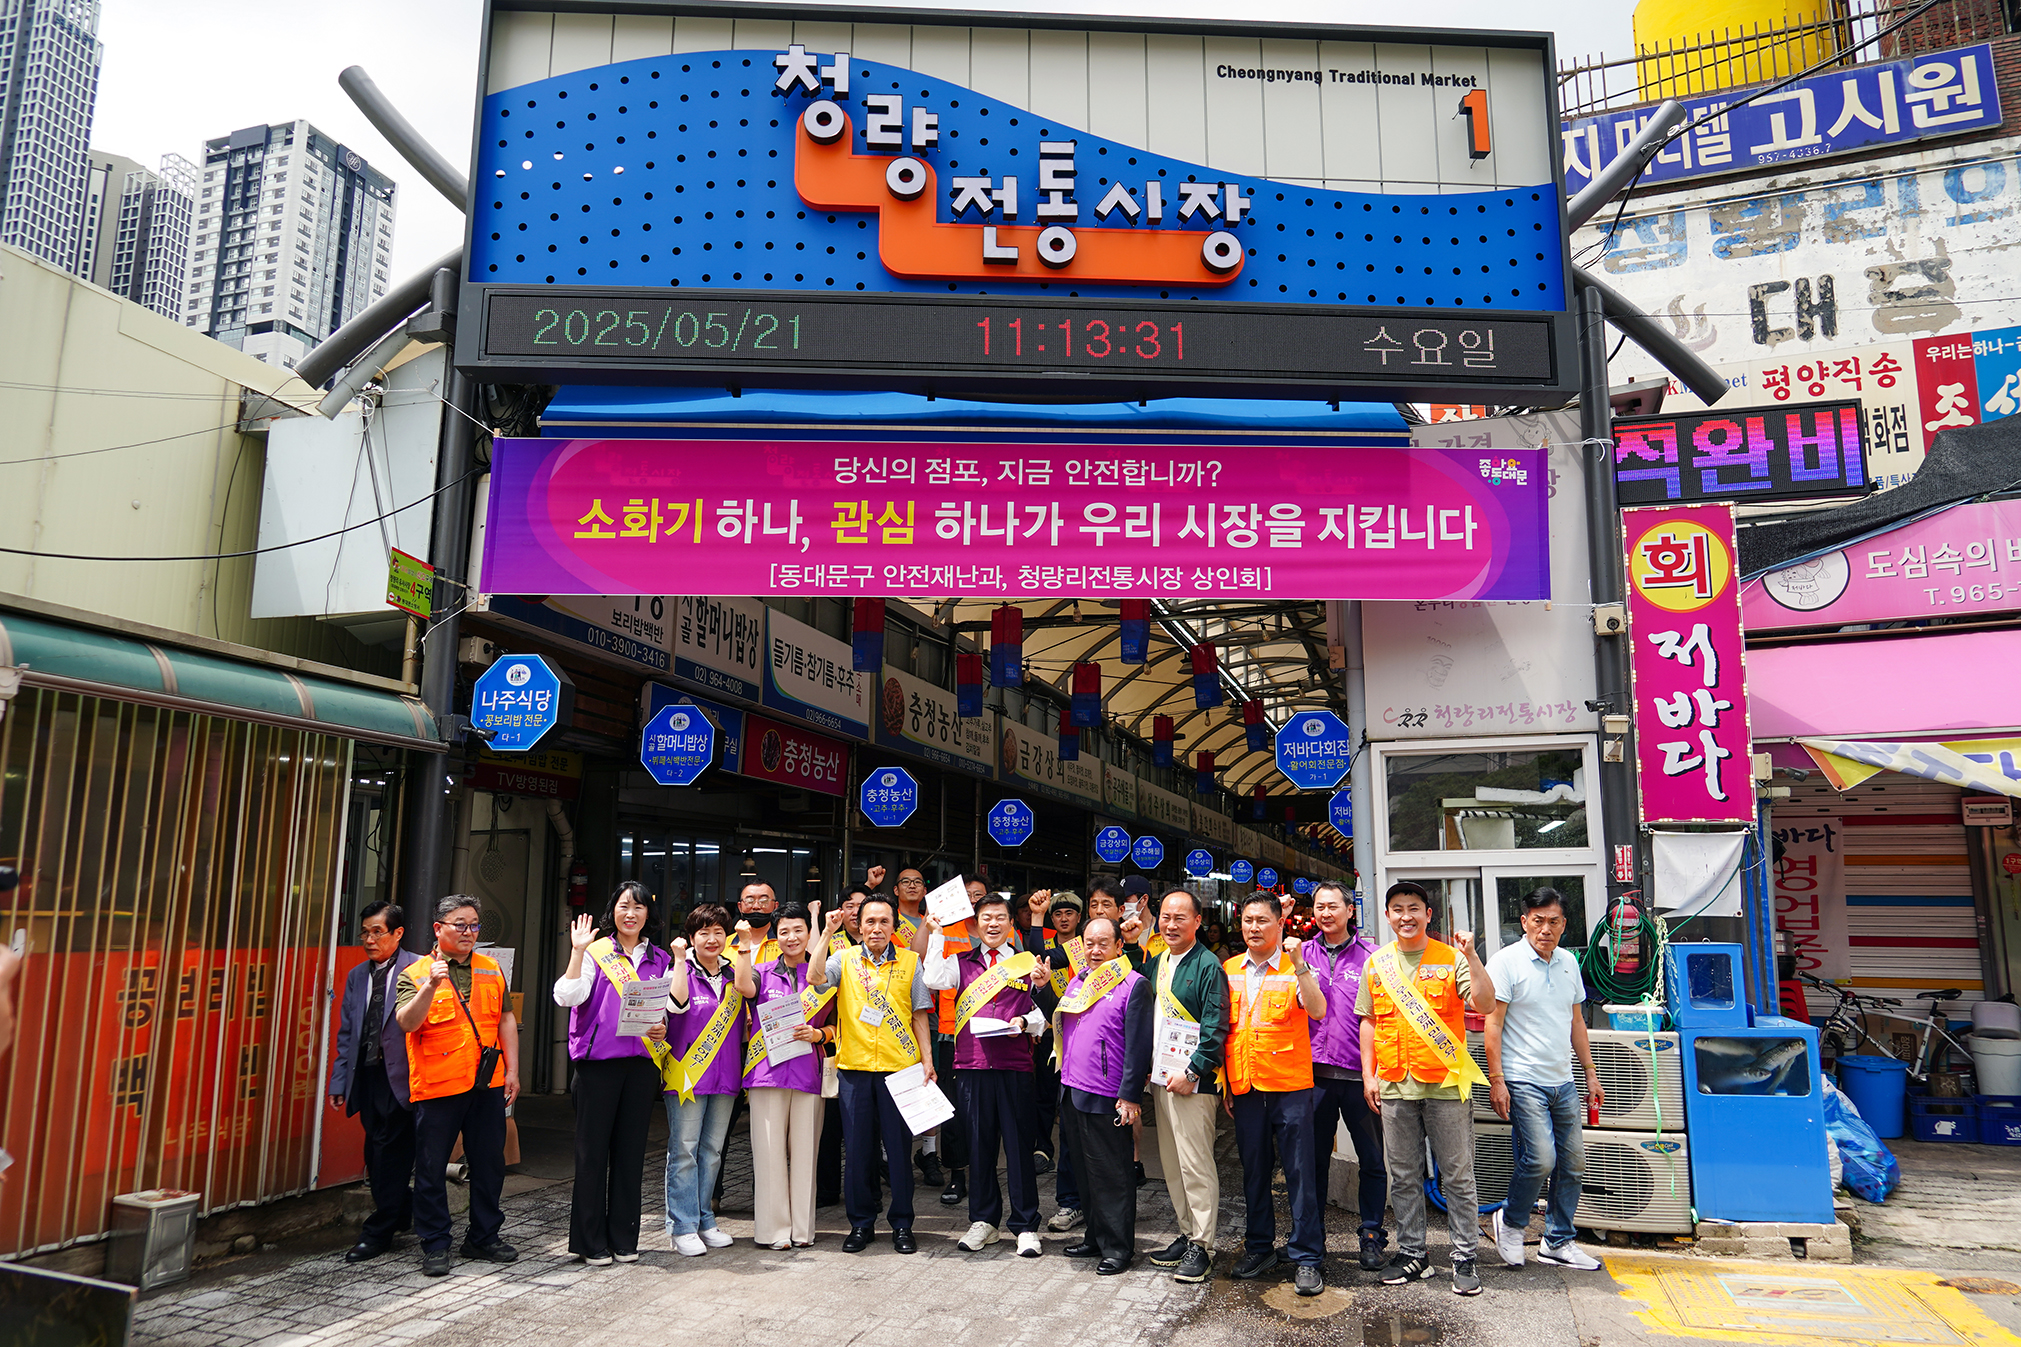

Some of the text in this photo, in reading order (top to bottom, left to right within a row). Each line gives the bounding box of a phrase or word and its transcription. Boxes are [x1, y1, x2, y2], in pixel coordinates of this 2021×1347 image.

[1216, 64, 1478, 88] Cheongnyang Traditional Market
[1459, 89, 1491, 159] 1
[1748, 54, 1984, 156] 고시원
[534, 306, 801, 352] 2025/05/21
[977, 316, 1185, 360] 11:13:31
[1364, 326, 1496, 368] 수요일
[1761, 351, 1903, 400] 평양직송
[833, 456, 917, 485] 당신의
[924, 457, 988, 487] 점포,
[996, 459, 1054, 488] 지금
[1065, 458, 1224, 489] 안전합니까?
[573, 497, 1478, 553] 소화기 하나, 관심 하나가 우리 시장을 지킵니다
[769, 563, 1272, 592] [동대문구 안전재난과, 청량리전통시장 상인회]
[1641, 532, 1713, 598] 회
[1865, 538, 1998, 580] 도심속의
[611, 608, 664, 645] 보리밥백반
[587, 627, 666, 668] 010-3900-3416
[481, 689, 552, 712] 나주식당
[524, 714, 544, 728] 전문
[908, 691, 964, 747] 충청농산
[1433, 700, 1578, 729] 청량리전통시장
[1647, 623, 1735, 801] 저바다
[656, 734, 708, 752] 할머니밥상
[783, 738, 840, 783] 충청농산
[1019, 739, 1065, 784] 금강상회
[1283, 740, 1351, 758] 저바다회집
[497, 771, 559, 795] TV방영된집
[1290, 759, 1346, 771] 활어회전문점
[866, 788, 913, 803] 충청농산
[992, 816, 1029, 828] 충청농산
